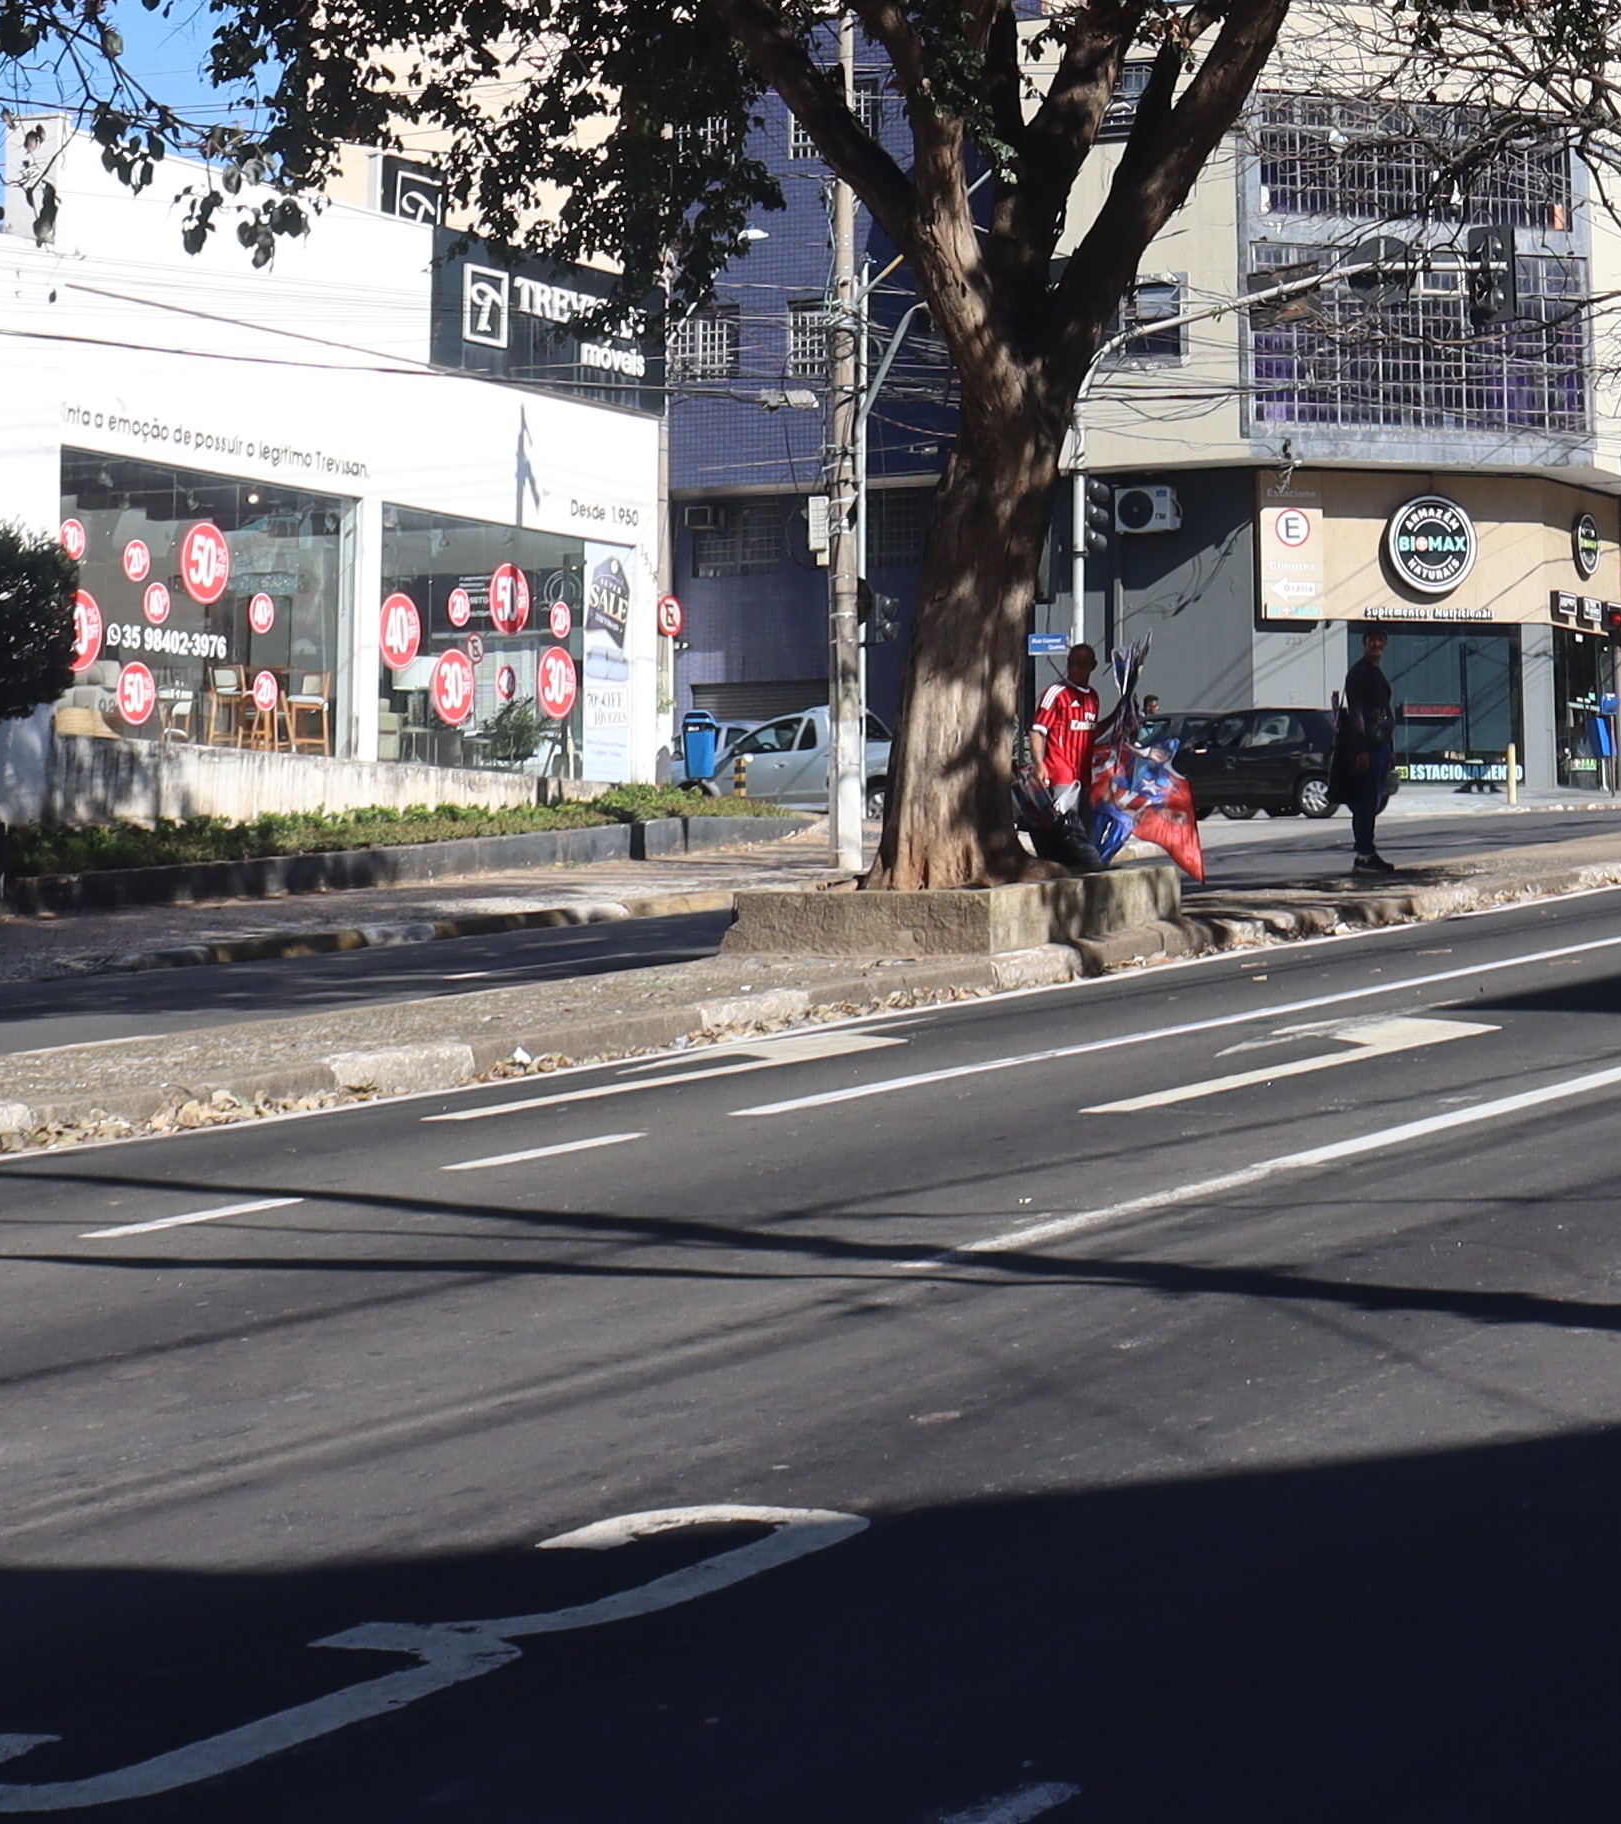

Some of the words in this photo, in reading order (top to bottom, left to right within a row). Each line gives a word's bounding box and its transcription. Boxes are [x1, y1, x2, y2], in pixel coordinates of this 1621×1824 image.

[581, 339, 646, 377] móveis
[94, 413, 104, 428] a
[108, 414, 169, 443] emoção
[174, 425, 191, 444] de
[246, 441, 256, 457] o
[570, 498, 606, 521] Desde
[611, 506, 639, 527] 1.950
[1405, 507, 1460, 530] ARMAZÉM
[1285, 517, 1300, 539] E
[1399, 536, 1466, 552] BIOMAX
[127, 547, 142, 574] 20
[190, 534, 216, 587] 50
[1269, 561, 1318, 572] Clientes
[1407, 558, 1460, 580] NATURAIS
[150, 588, 163, 616] 40
[497, 576, 516, 622] 50
[589, 584, 629, 624] SALE
[1366, 606, 1430, 619] Suplementos
[122, 624, 141, 649] 35
[143, 627, 227, 659] 98402-3976
[386, 606, 409, 654] 40
[123, 672, 144, 713] 50
[257, 678, 270, 704] 20
[441, 662, 463, 709] 30
[545, 657, 567, 704] 30
[1409, 763, 1523, 781] ESTACIONAMENO
